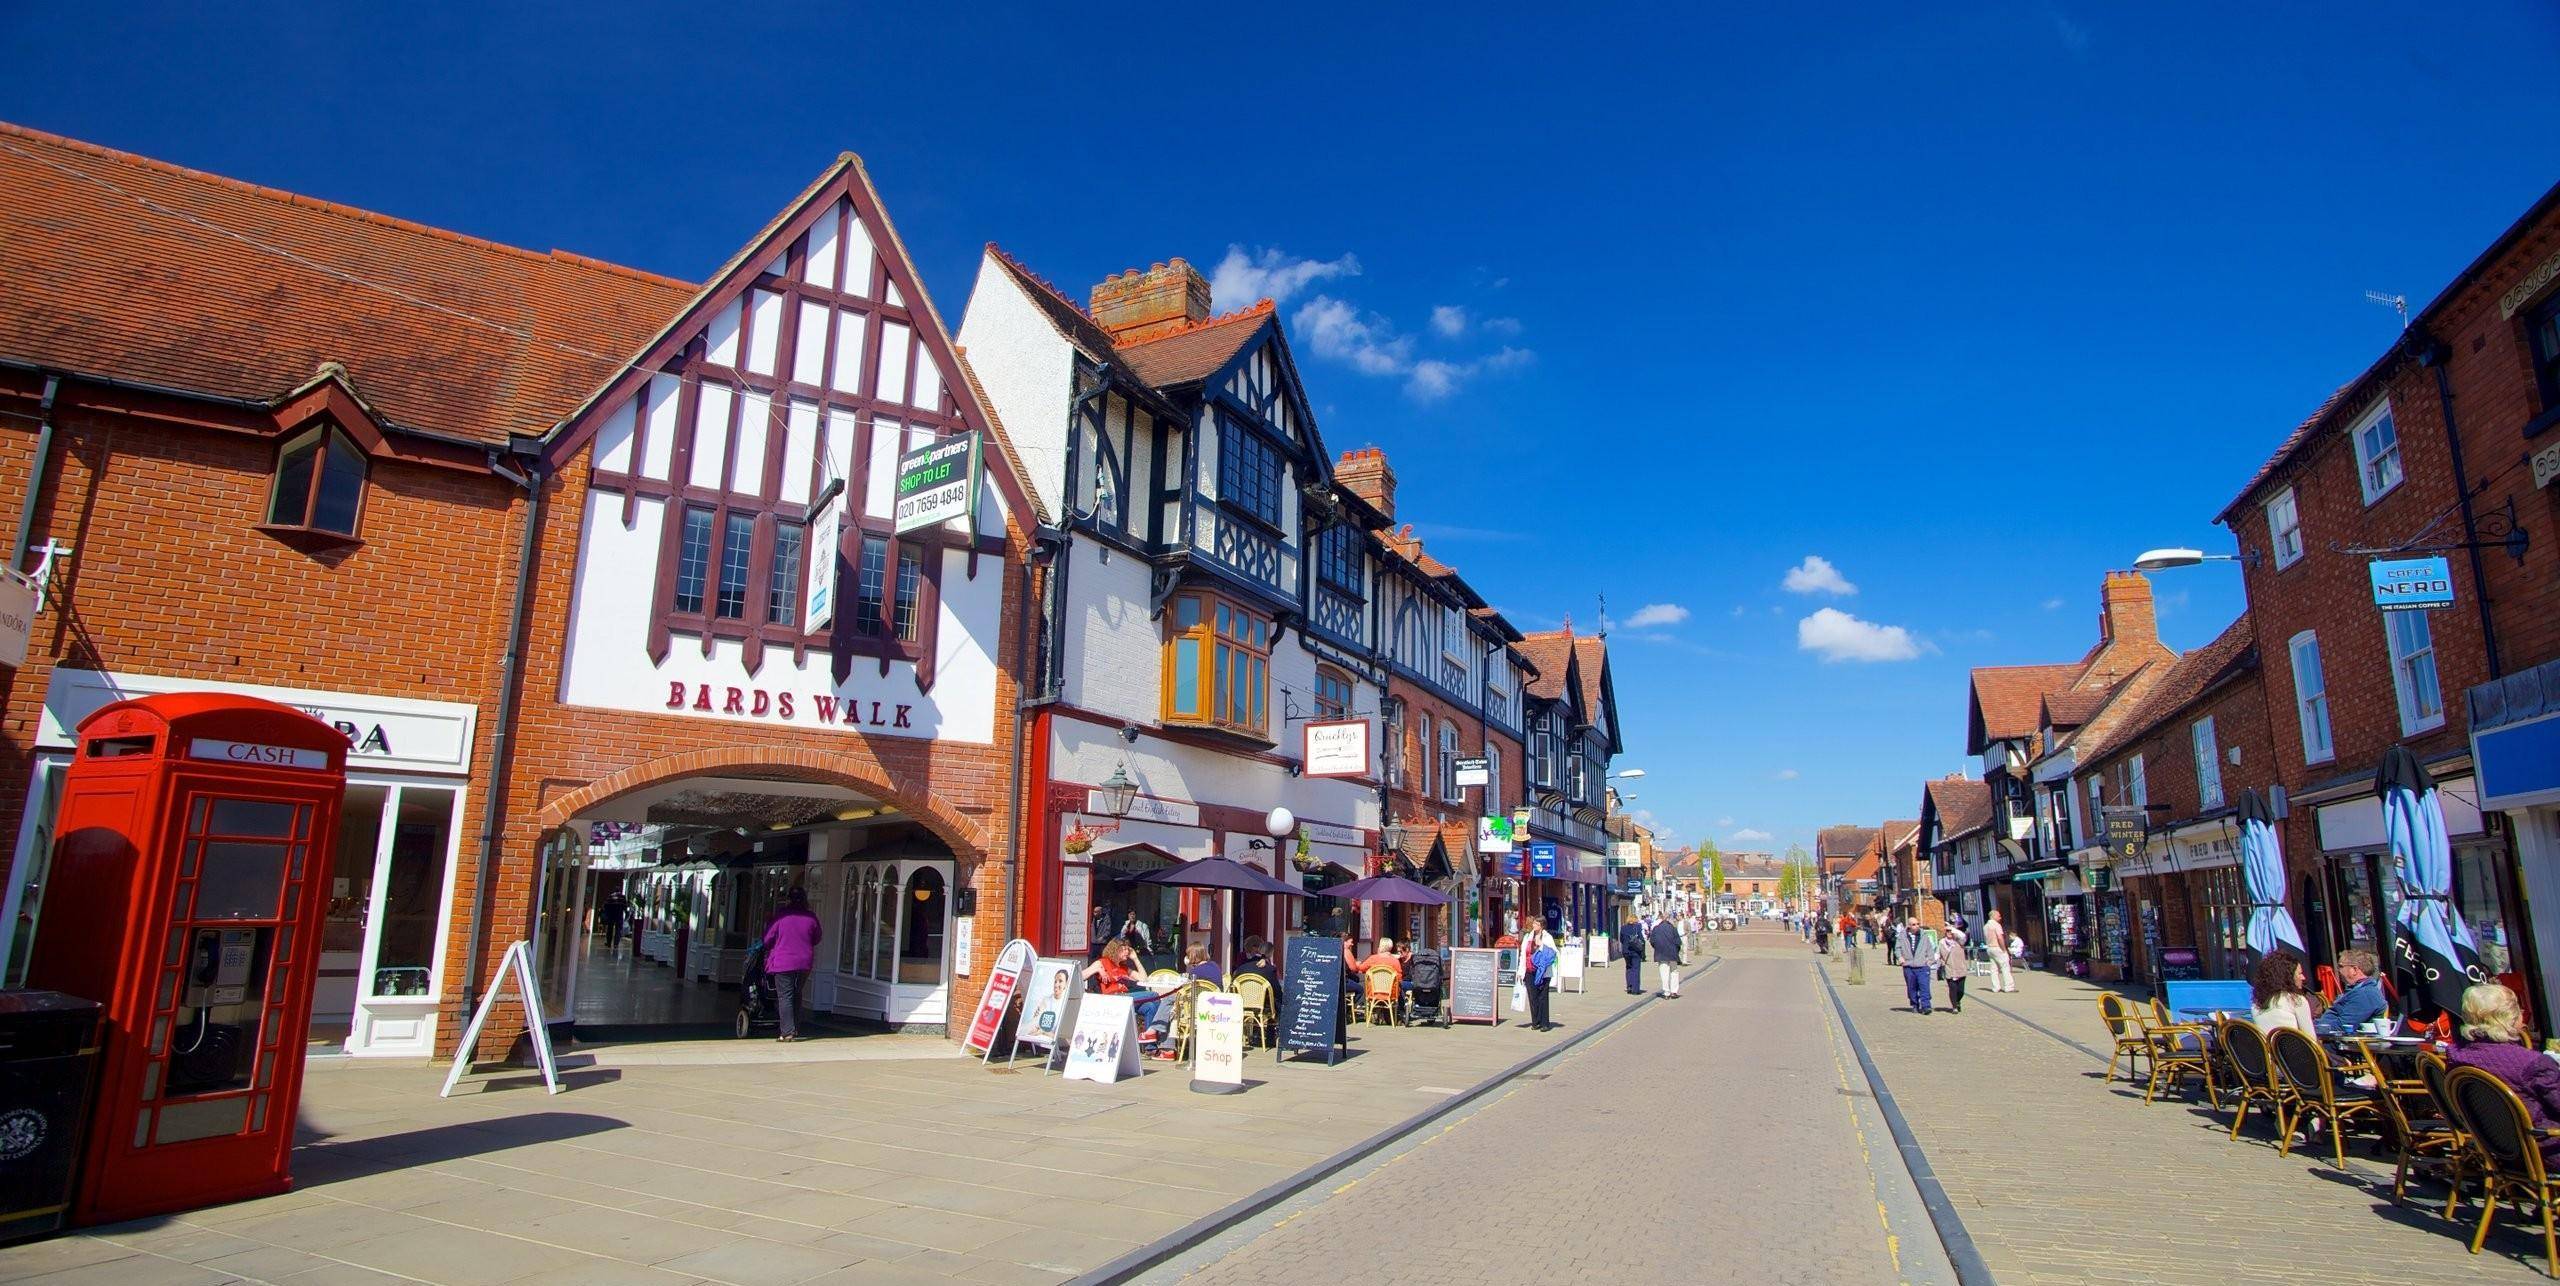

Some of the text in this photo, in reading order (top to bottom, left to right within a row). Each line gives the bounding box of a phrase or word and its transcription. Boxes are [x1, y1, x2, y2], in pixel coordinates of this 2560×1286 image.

[901, 440, 969, 475] green&partners
[900, 463, 951, 492] SHOP TO LET
[898, 485, 964, 520] 020 7659 4848
[2378, 581, 2447, 595] NERO
[666, 681, 912, 728] BARDS WALK
[227, 744, 295, 765] CASH
[2110, 821, 2134, 829] FRED
[2110, 830, 2145, 840] WINTER
[2125, 842, 2135, 855] 8
[2189, 842, 2209, 858] FRED
[2212, 835, 2240, 853] WINTE
[1209, 1029, 1230, 1043] Toy
[1204, 1050, 1232, 1067] Shop
